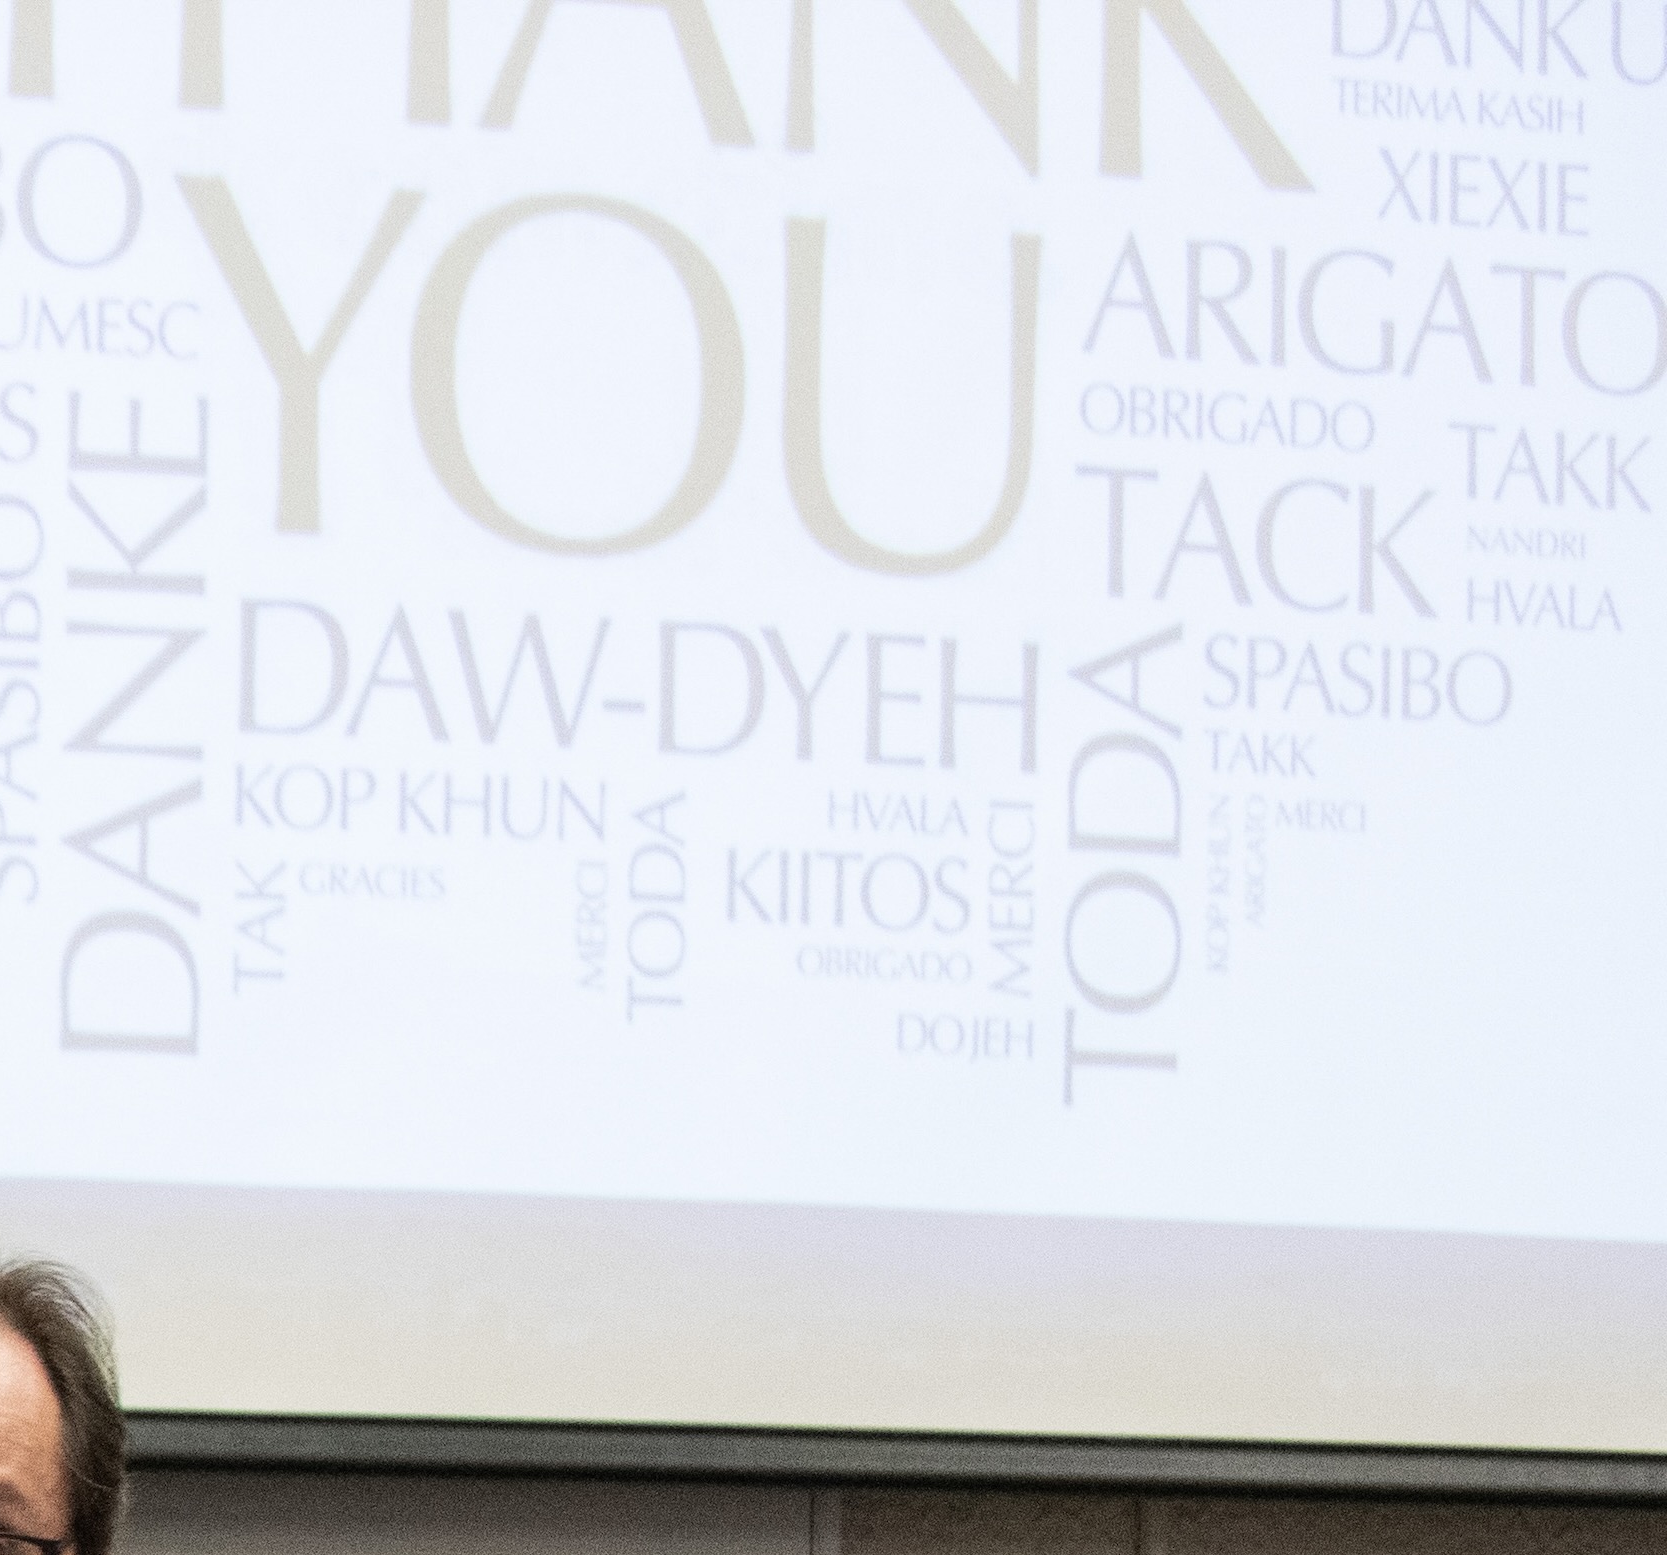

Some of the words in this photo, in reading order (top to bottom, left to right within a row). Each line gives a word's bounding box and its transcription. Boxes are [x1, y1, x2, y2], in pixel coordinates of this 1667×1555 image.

[1331, 0, 1589, 80] DANK
[1332, 76, 1467, 125] TERIMA
[1477, 89, 1585, 135] KASIH
[1378, 146, 1591, 238] XIEXIE
[1080, 229, 1667, 398] ARIGATO
[173, 168, 1043, 580] YOU
[1078, 380, 1377, 454] OBRIGADO
[1448, 421, 1653, 514] TAKK
[1074, 463, 1439, 621] TACK
[1466, 524, 1588, 562] NANDRI
[1466, 577, 1624, 634] HVALA
[61, 390, 209, 1057] DANKE
[237, 597, 1040, 776] DAW-DYEH
[1202, 632, 1514, 728] SPASIBO
[1204, 727, 1317, 780] TAKK
[234, 763, 378, 832] KOP
[398, 771, 608, 842] KHUN
[827, 790, 970, 838] HVALA
[1275, 799, 1368, 834] MERCI
[298, 861, 447, 899] GRACIES
[626, 789, 687, 1024] TODA
[725, 846, 972, 936] KIITOS
[986, 798, 1036, 1000] MERCI
[1062, 621, 1185, 1108] TODA
[232, 859, 287, 996] TAK
[574, 859, 609, 993] MERCI
[795, 945, 974, 985] OBRIGADO
